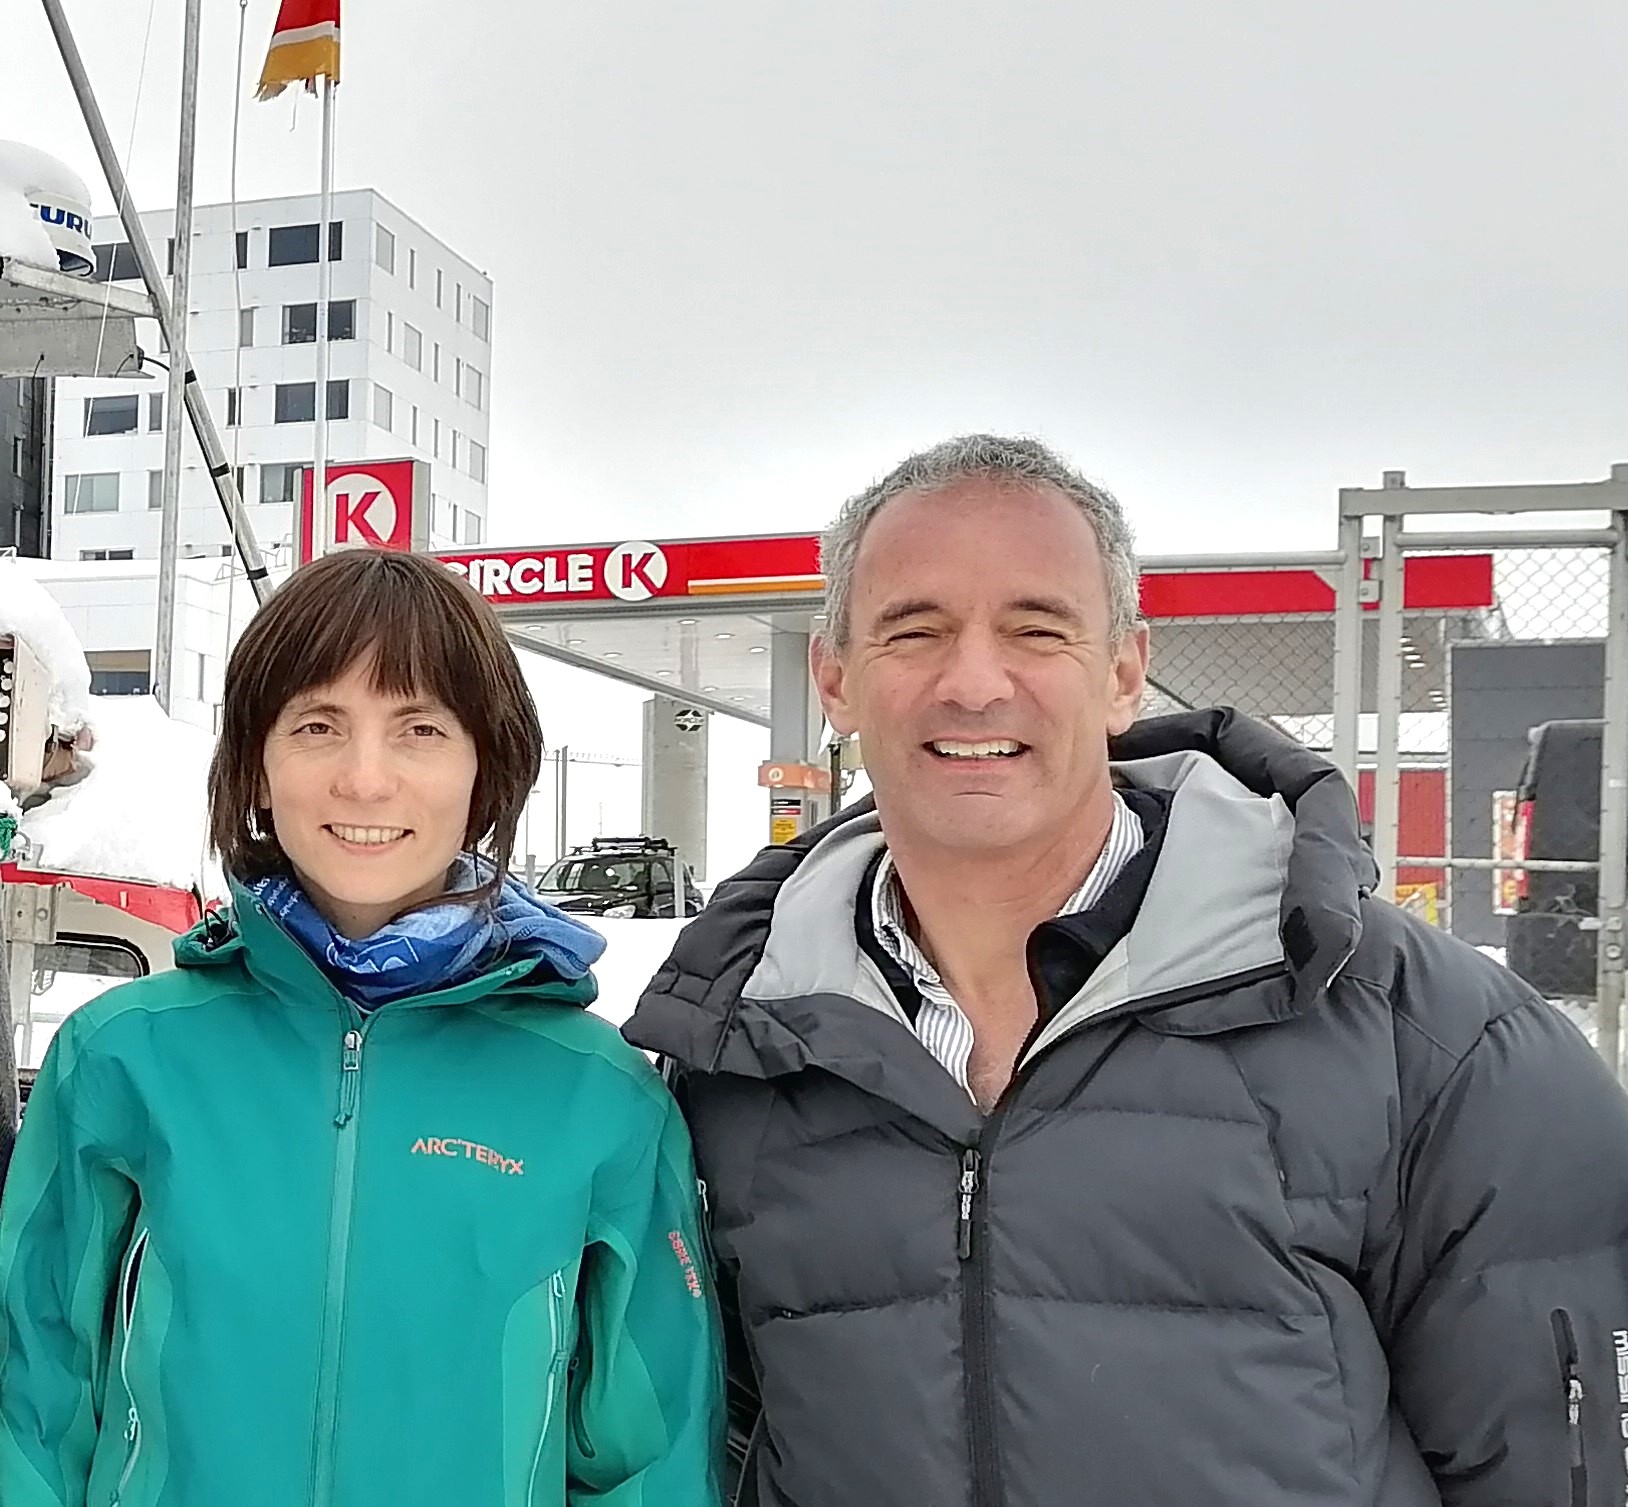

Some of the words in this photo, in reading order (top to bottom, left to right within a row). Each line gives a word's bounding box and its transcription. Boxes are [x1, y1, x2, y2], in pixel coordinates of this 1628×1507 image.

[29, 202, 92, 240] URU
[334, 490, 385, 547] K
[621, 552, 660, 596] K
